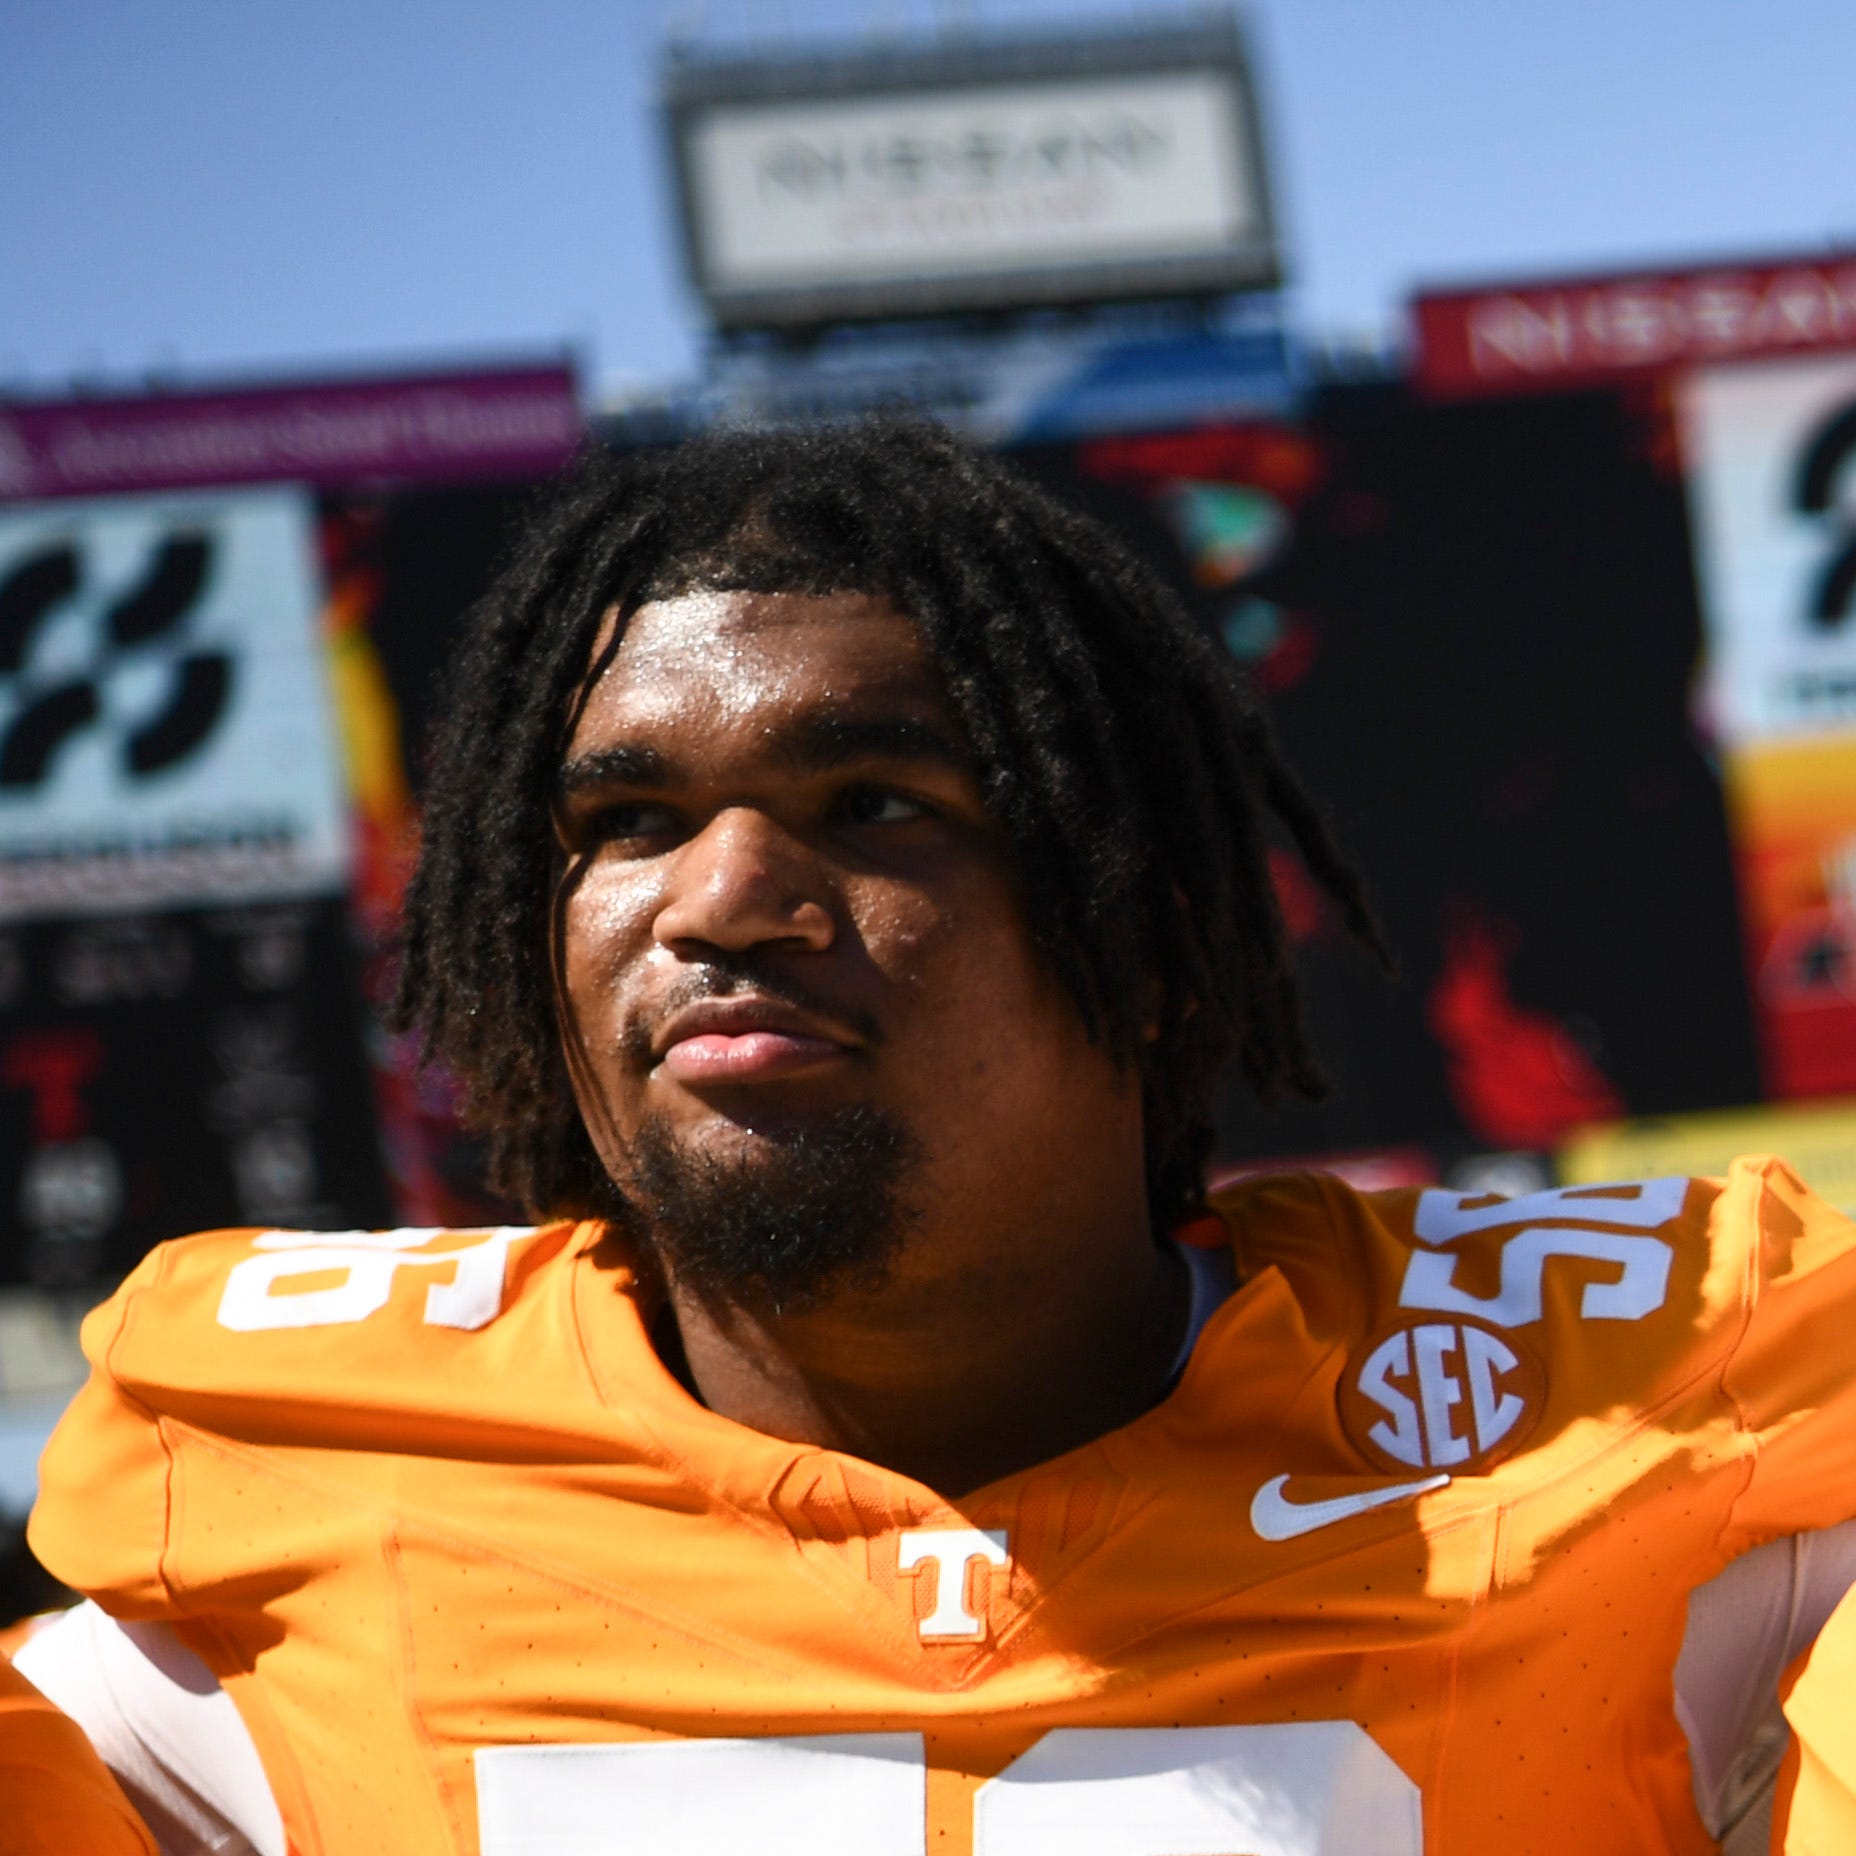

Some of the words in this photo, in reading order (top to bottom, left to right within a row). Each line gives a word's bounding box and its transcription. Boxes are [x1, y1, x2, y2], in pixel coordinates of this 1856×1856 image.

[752, 104, 1176, 202] NISSAN
[1356, 1323, 1525, 1469] SEC
[899, 1529, 1008, 1635] T
